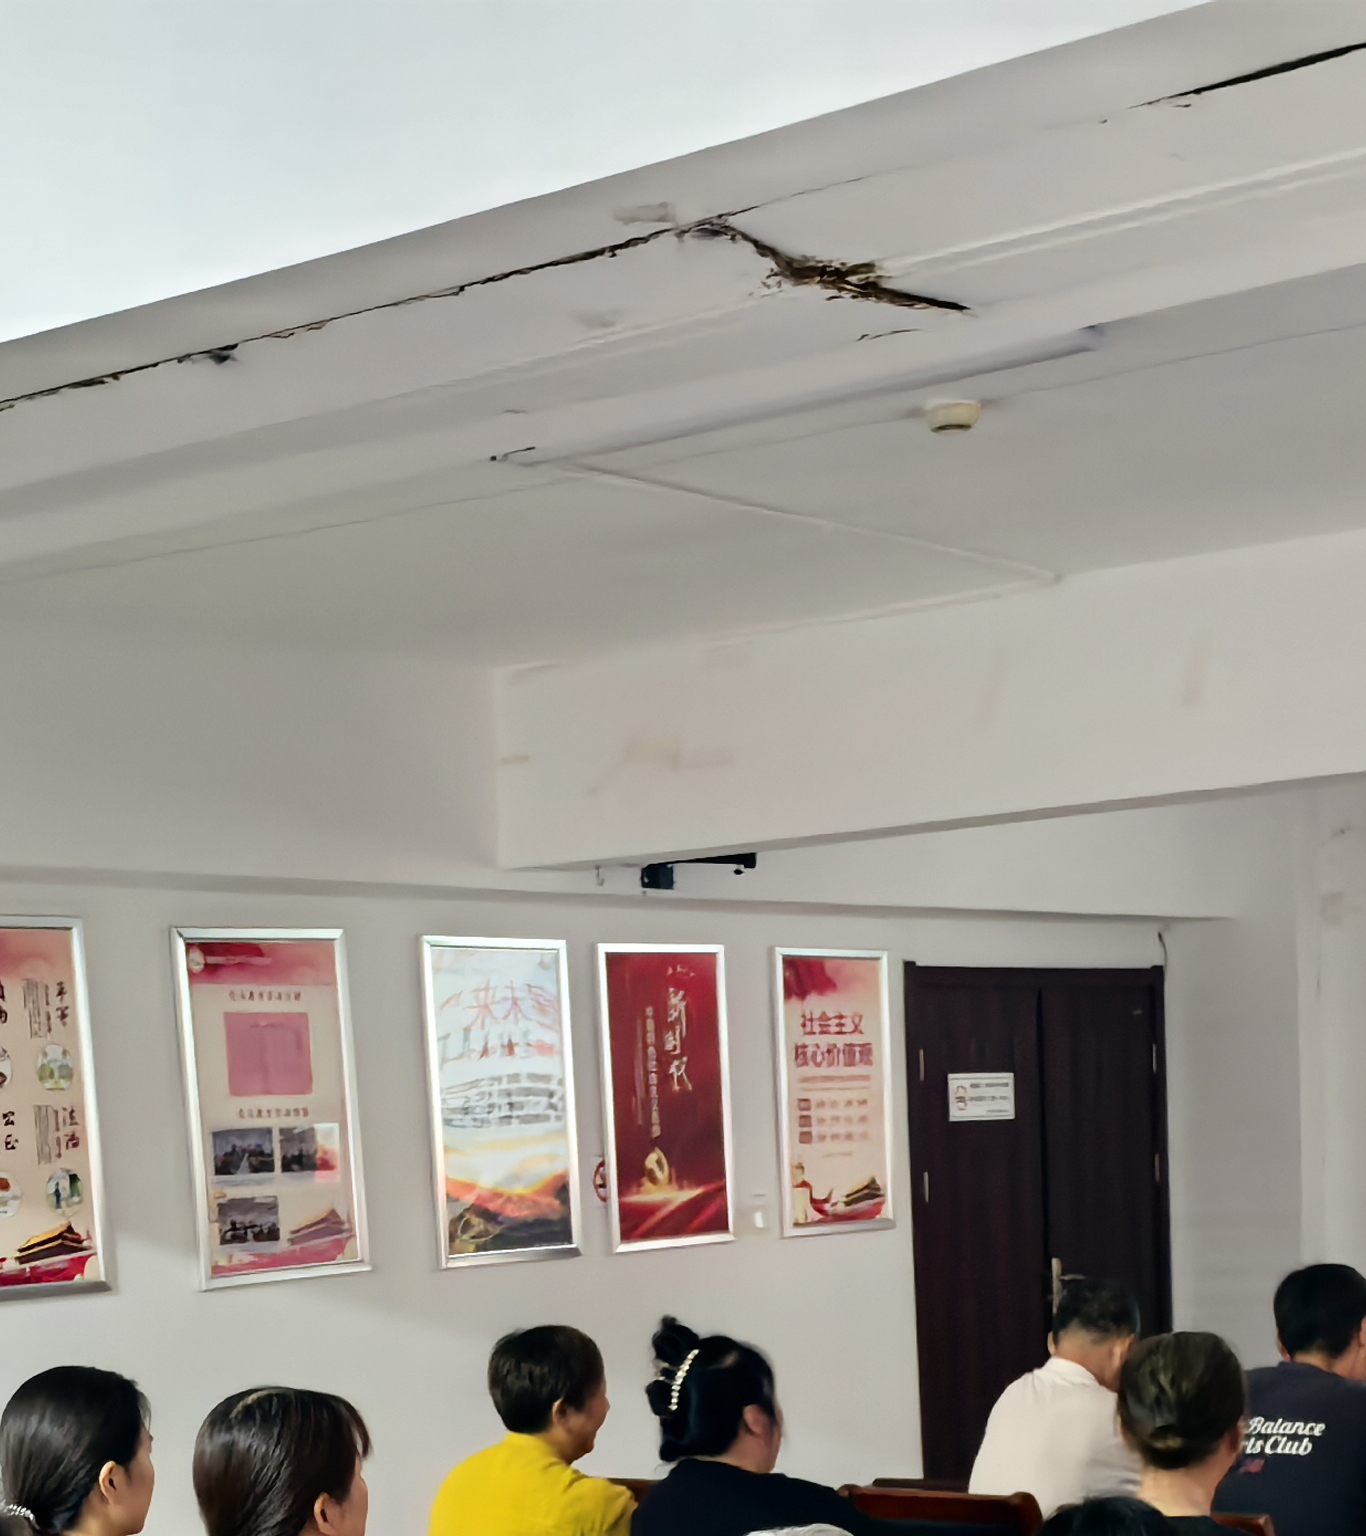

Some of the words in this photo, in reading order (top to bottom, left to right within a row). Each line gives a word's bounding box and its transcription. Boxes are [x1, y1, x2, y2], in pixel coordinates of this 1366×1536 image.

[800, 1010, 865, 1035] 社会主义
[794, 1043, 873, 1068] 核心价值观
[1246, 1416, 1326, 1437] Balance
[1265, 1435, 1313, 1456] Club
